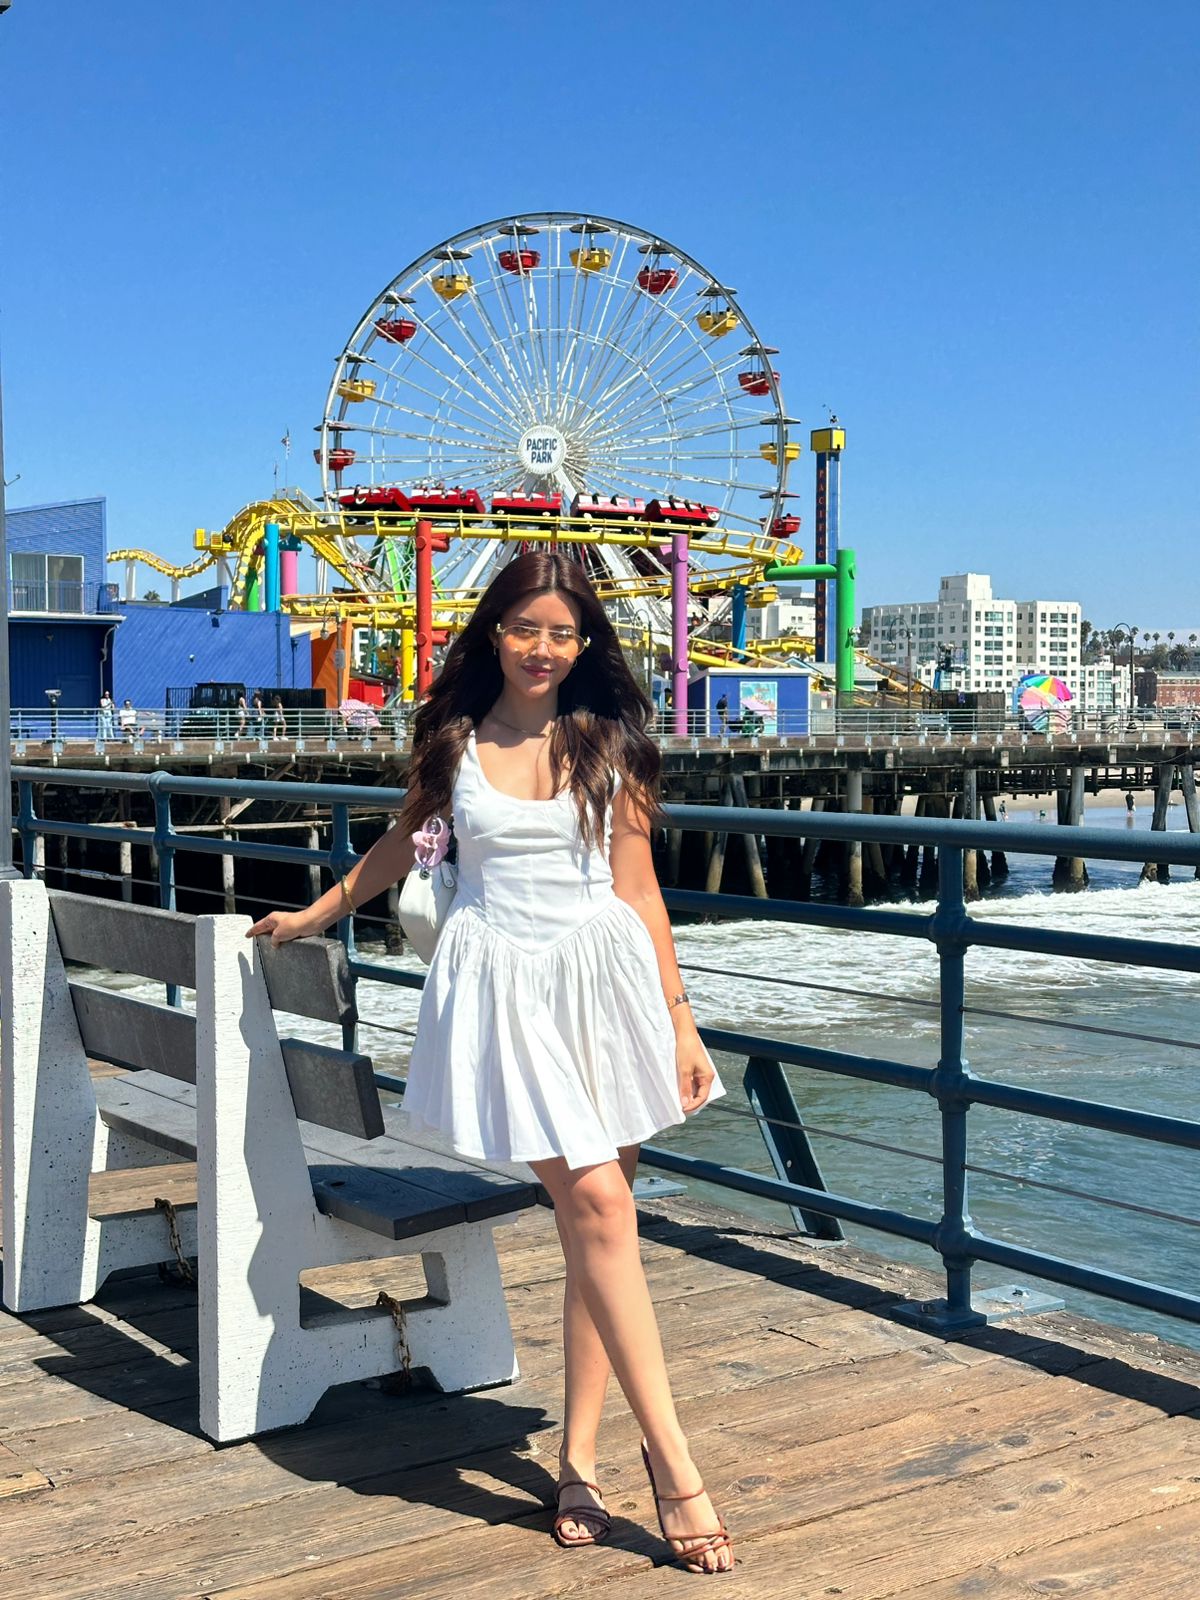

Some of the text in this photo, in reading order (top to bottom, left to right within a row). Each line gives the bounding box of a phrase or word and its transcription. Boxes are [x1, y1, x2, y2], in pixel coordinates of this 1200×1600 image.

[526, 438, 557, 450] PACIFIC
[531, 451, 553, 463] PARK
[817, 469, 825, 645] PACIFIC LUNGE
